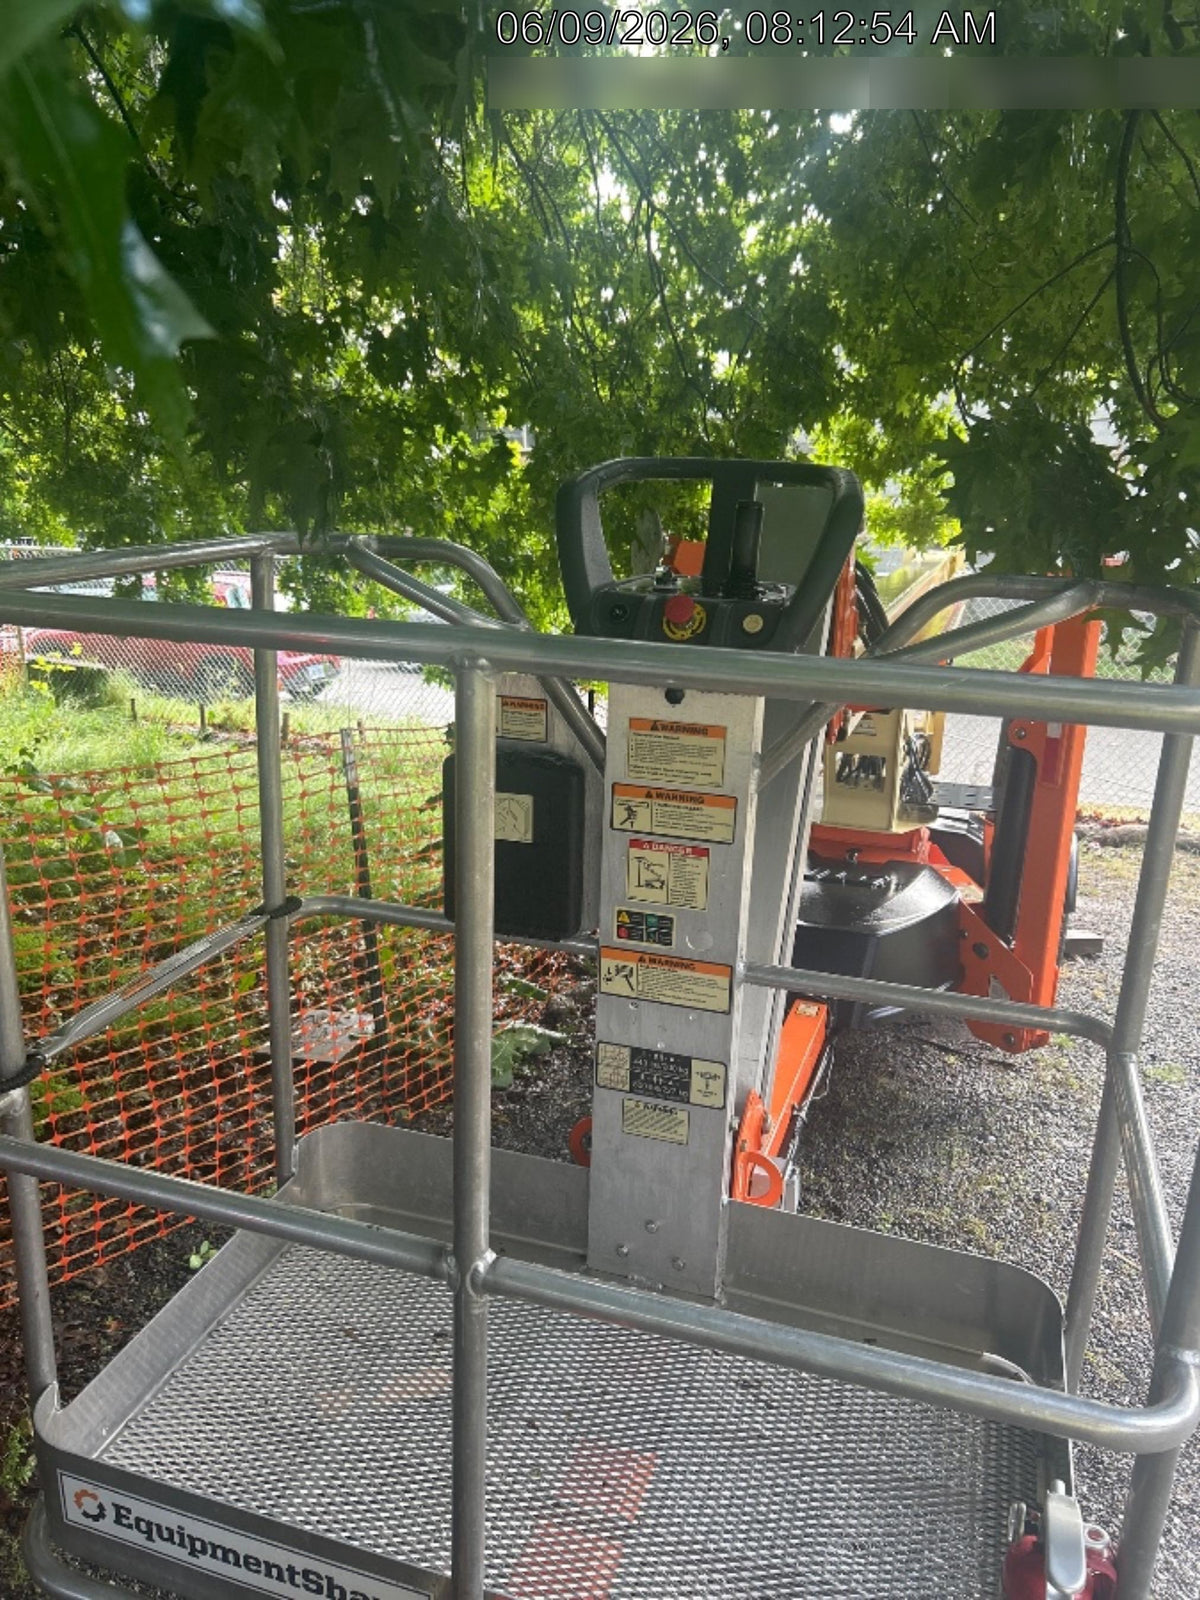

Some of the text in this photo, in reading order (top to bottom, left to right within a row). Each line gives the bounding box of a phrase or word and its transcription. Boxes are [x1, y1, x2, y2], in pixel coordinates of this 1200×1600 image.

[659, 723, 709, 736] WARNING
[655, 791, 705, 805] WARNING
[651, 843, 693, 855] DANGER
[648, 956, 697, 971] WARNING
[112, 1501, 381, 1600] EquipmentSha
